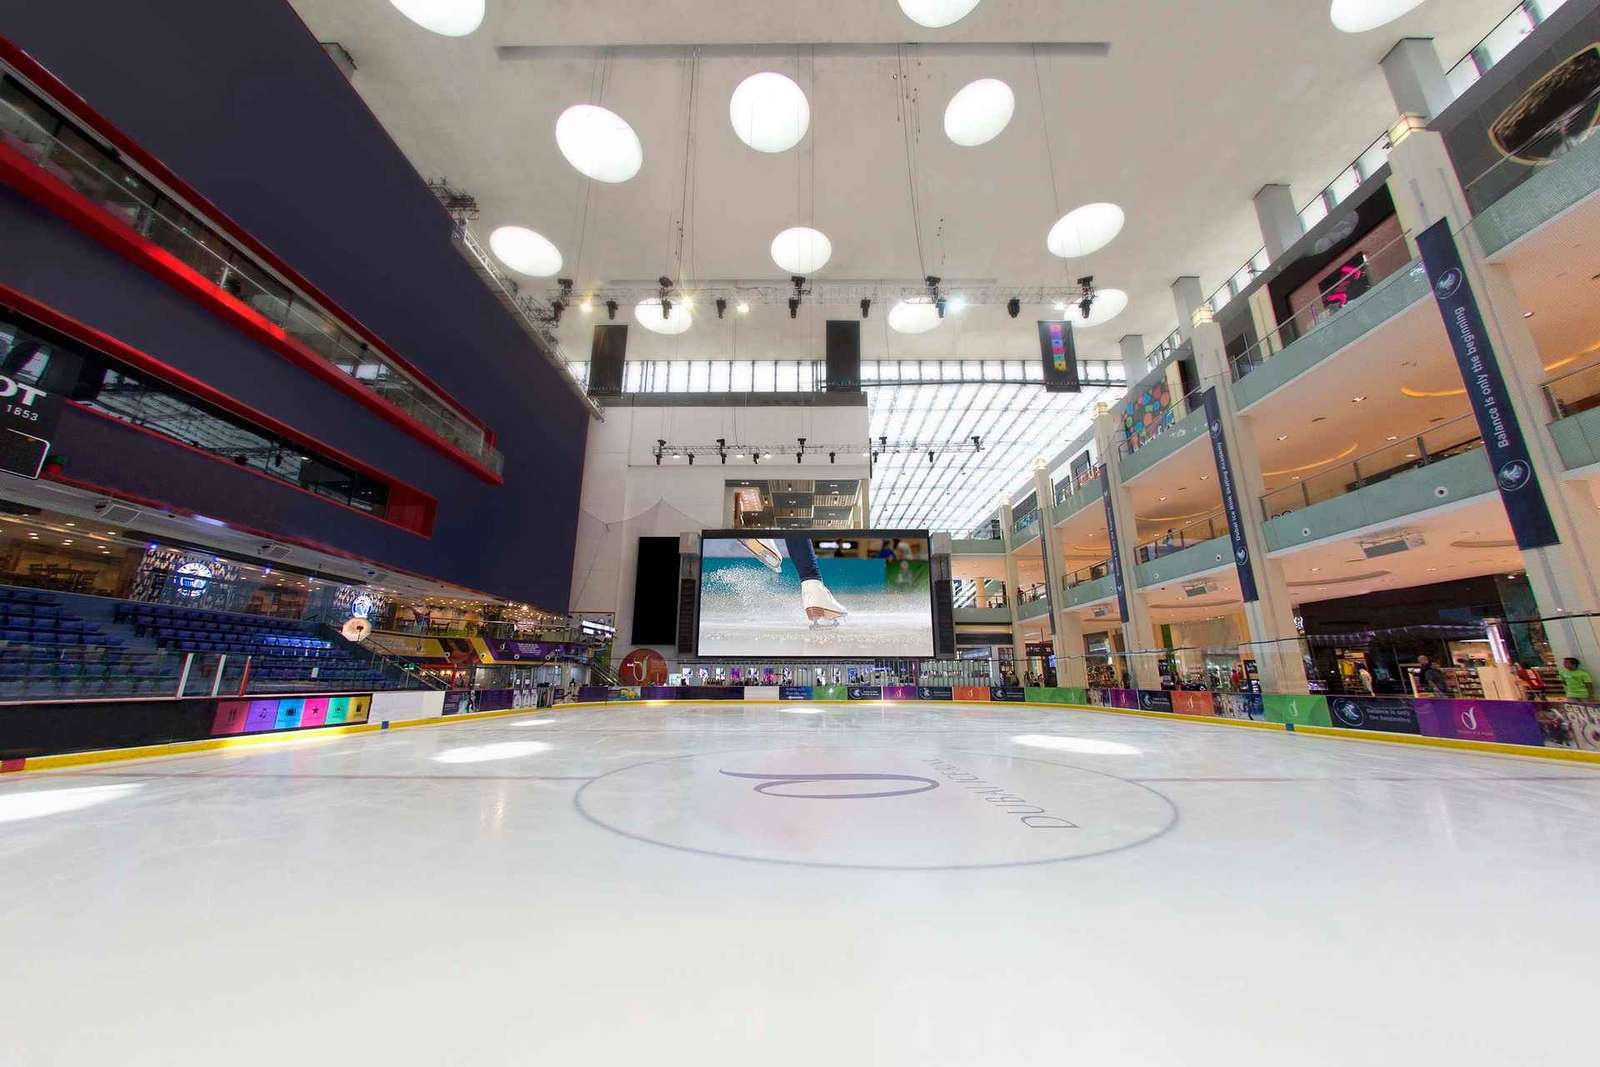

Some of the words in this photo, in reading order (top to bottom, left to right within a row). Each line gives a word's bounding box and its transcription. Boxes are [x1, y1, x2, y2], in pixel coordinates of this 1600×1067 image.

[1454, 306, 1477, 358] beginning
[1470, 354, 1485, 374] the
[1476, 369, 1492, 395] only
[7, 404, 39, 421] 1853
[1488, 408, 1509, 449] Balance
[965, 786, 1081, 828] DUBAI
